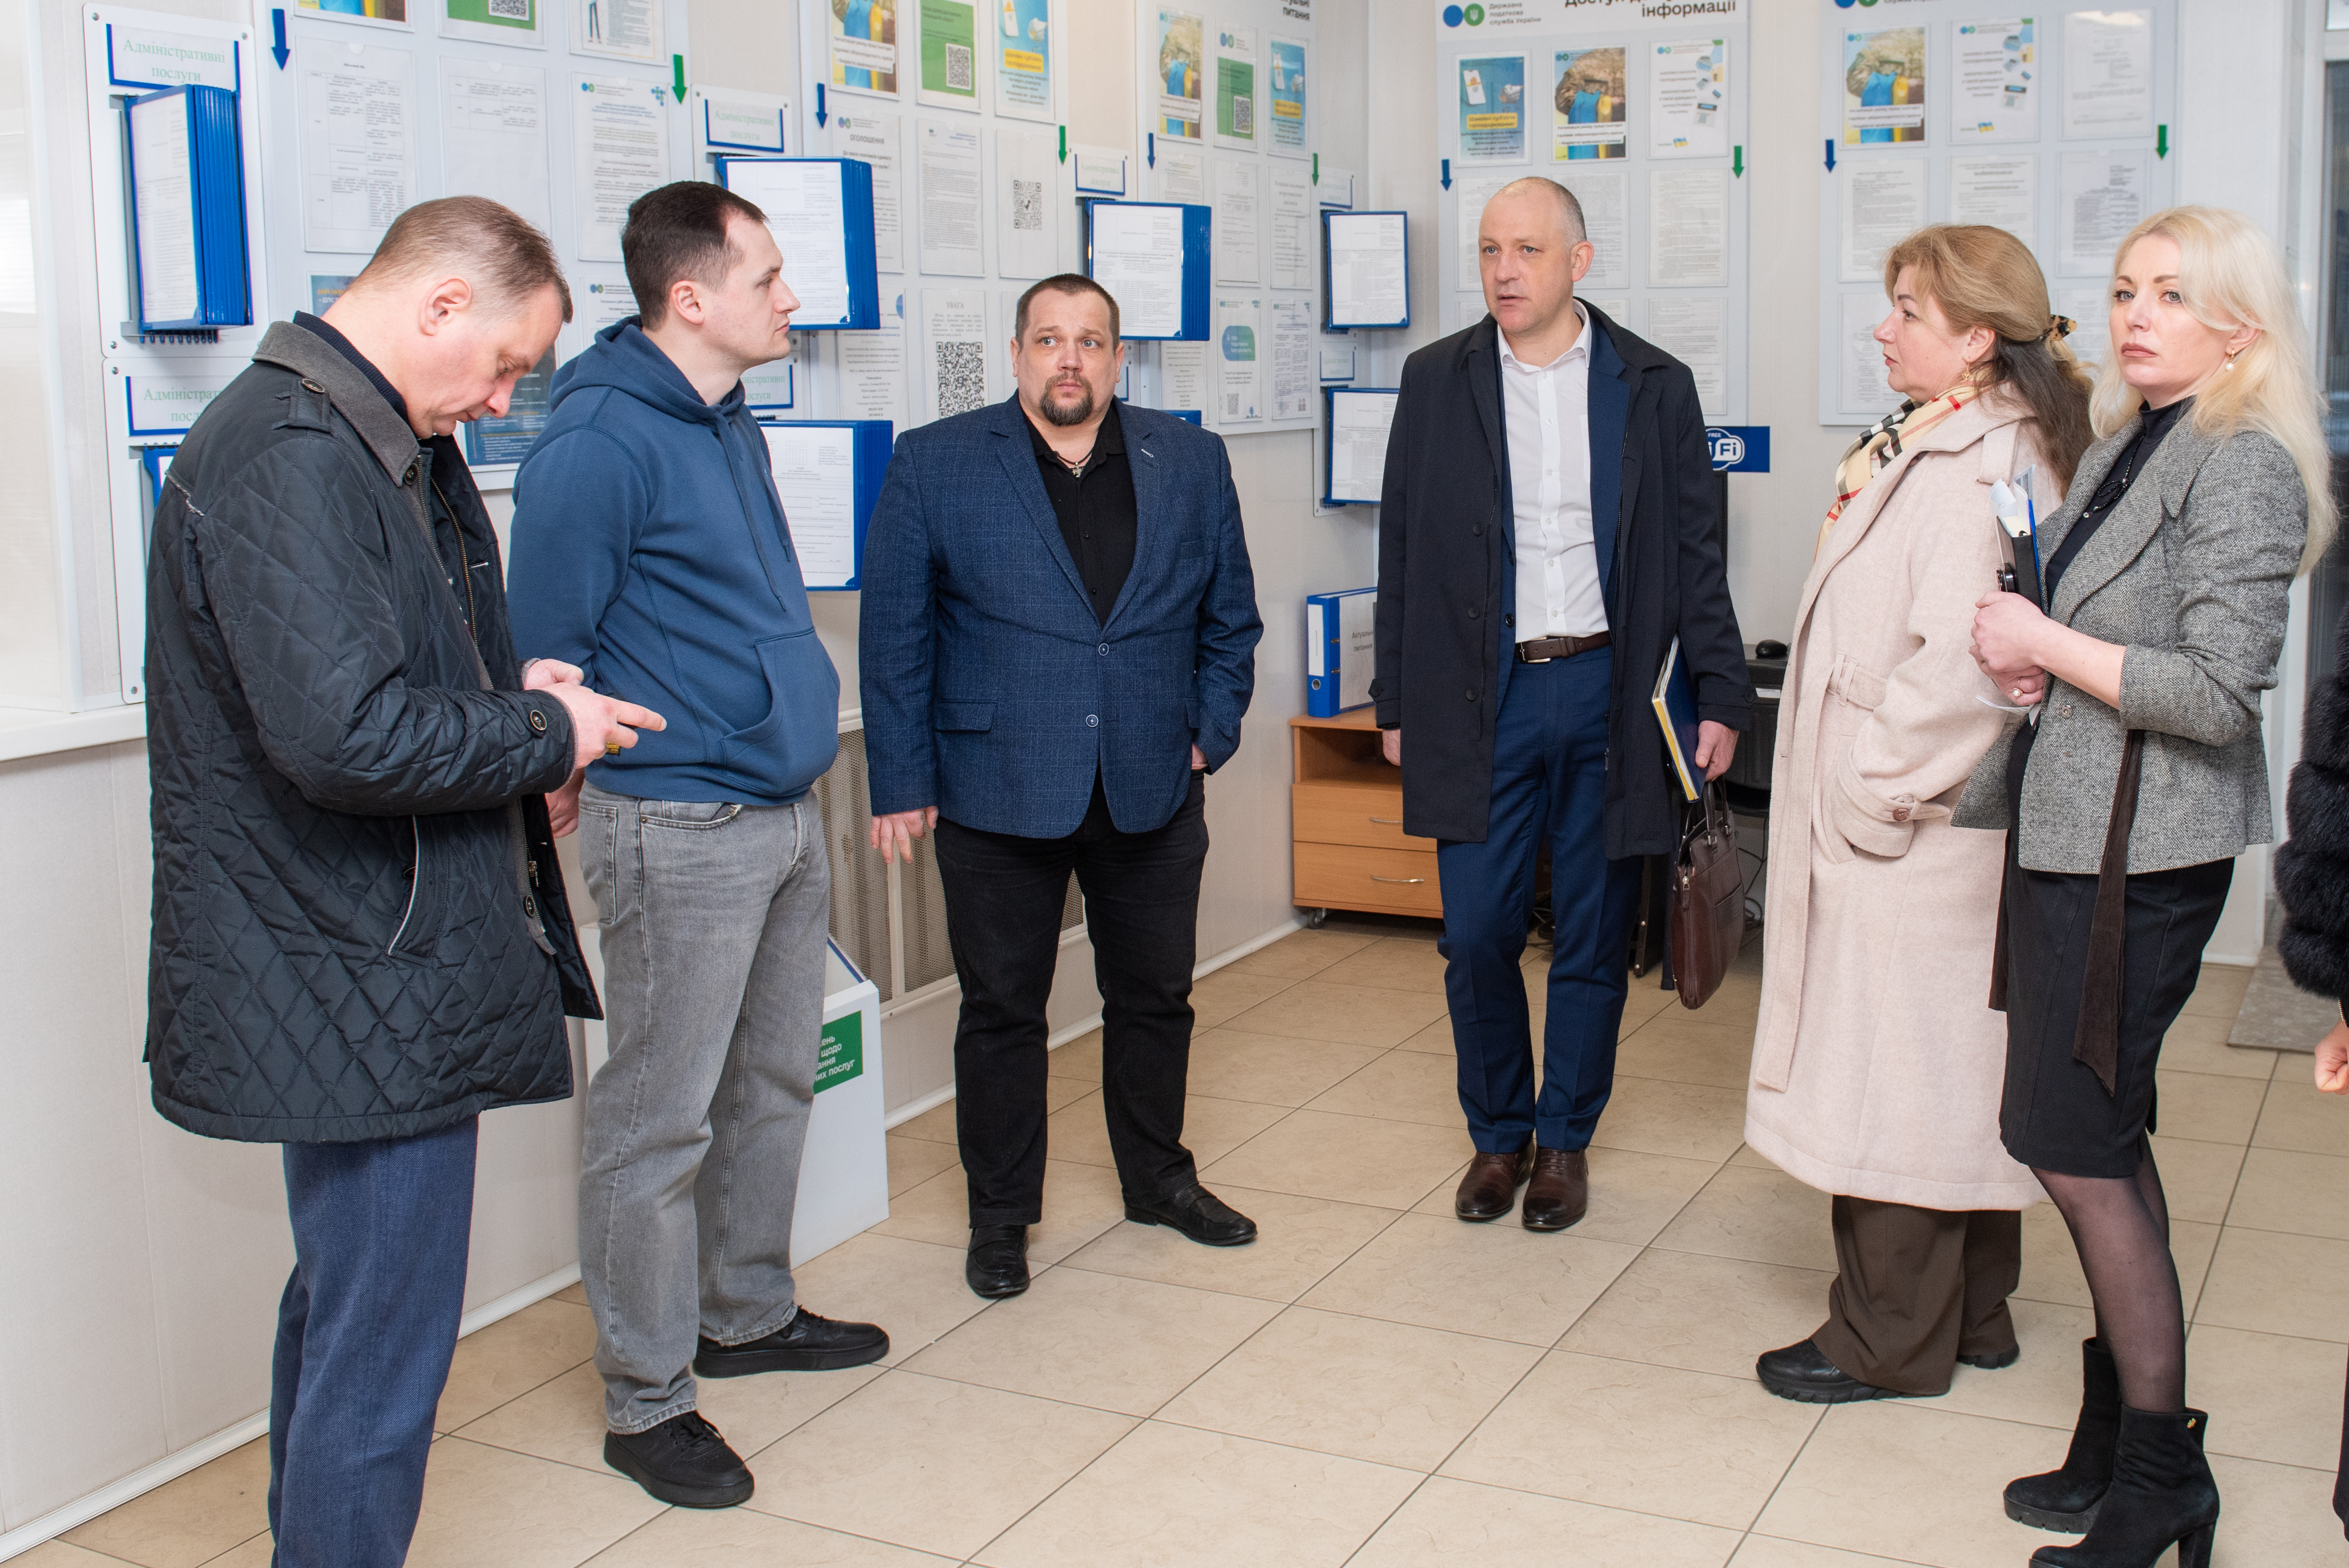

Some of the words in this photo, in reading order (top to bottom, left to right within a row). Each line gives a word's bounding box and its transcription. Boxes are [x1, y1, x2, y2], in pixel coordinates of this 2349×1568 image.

[1282, 6, 1310, 21] питання
[1642, 0, 1736, 19] інформації
[123, 38, 225, 63] Адміністративні
[151, 67, 201, 83] послуги
[714, 110, 774, 126] Адміністративні
[730, 131, 760, 142] послуги
[850, 134, 885, 145] ОГОЛОШЕННЯ
[144, 387, 222, 403] Адміністрат
[746, 392, 771, 402] ослуги
[1720, 442, 1737, 456] Fi
[820, 1035, 836, 1047] ень
[821, 1043, 843, 1057] щодо
[815, 1070, 827, 1081] их
[828, 1059, 856, 1076] послуг
[817, 1056, 836, 1070] ання
